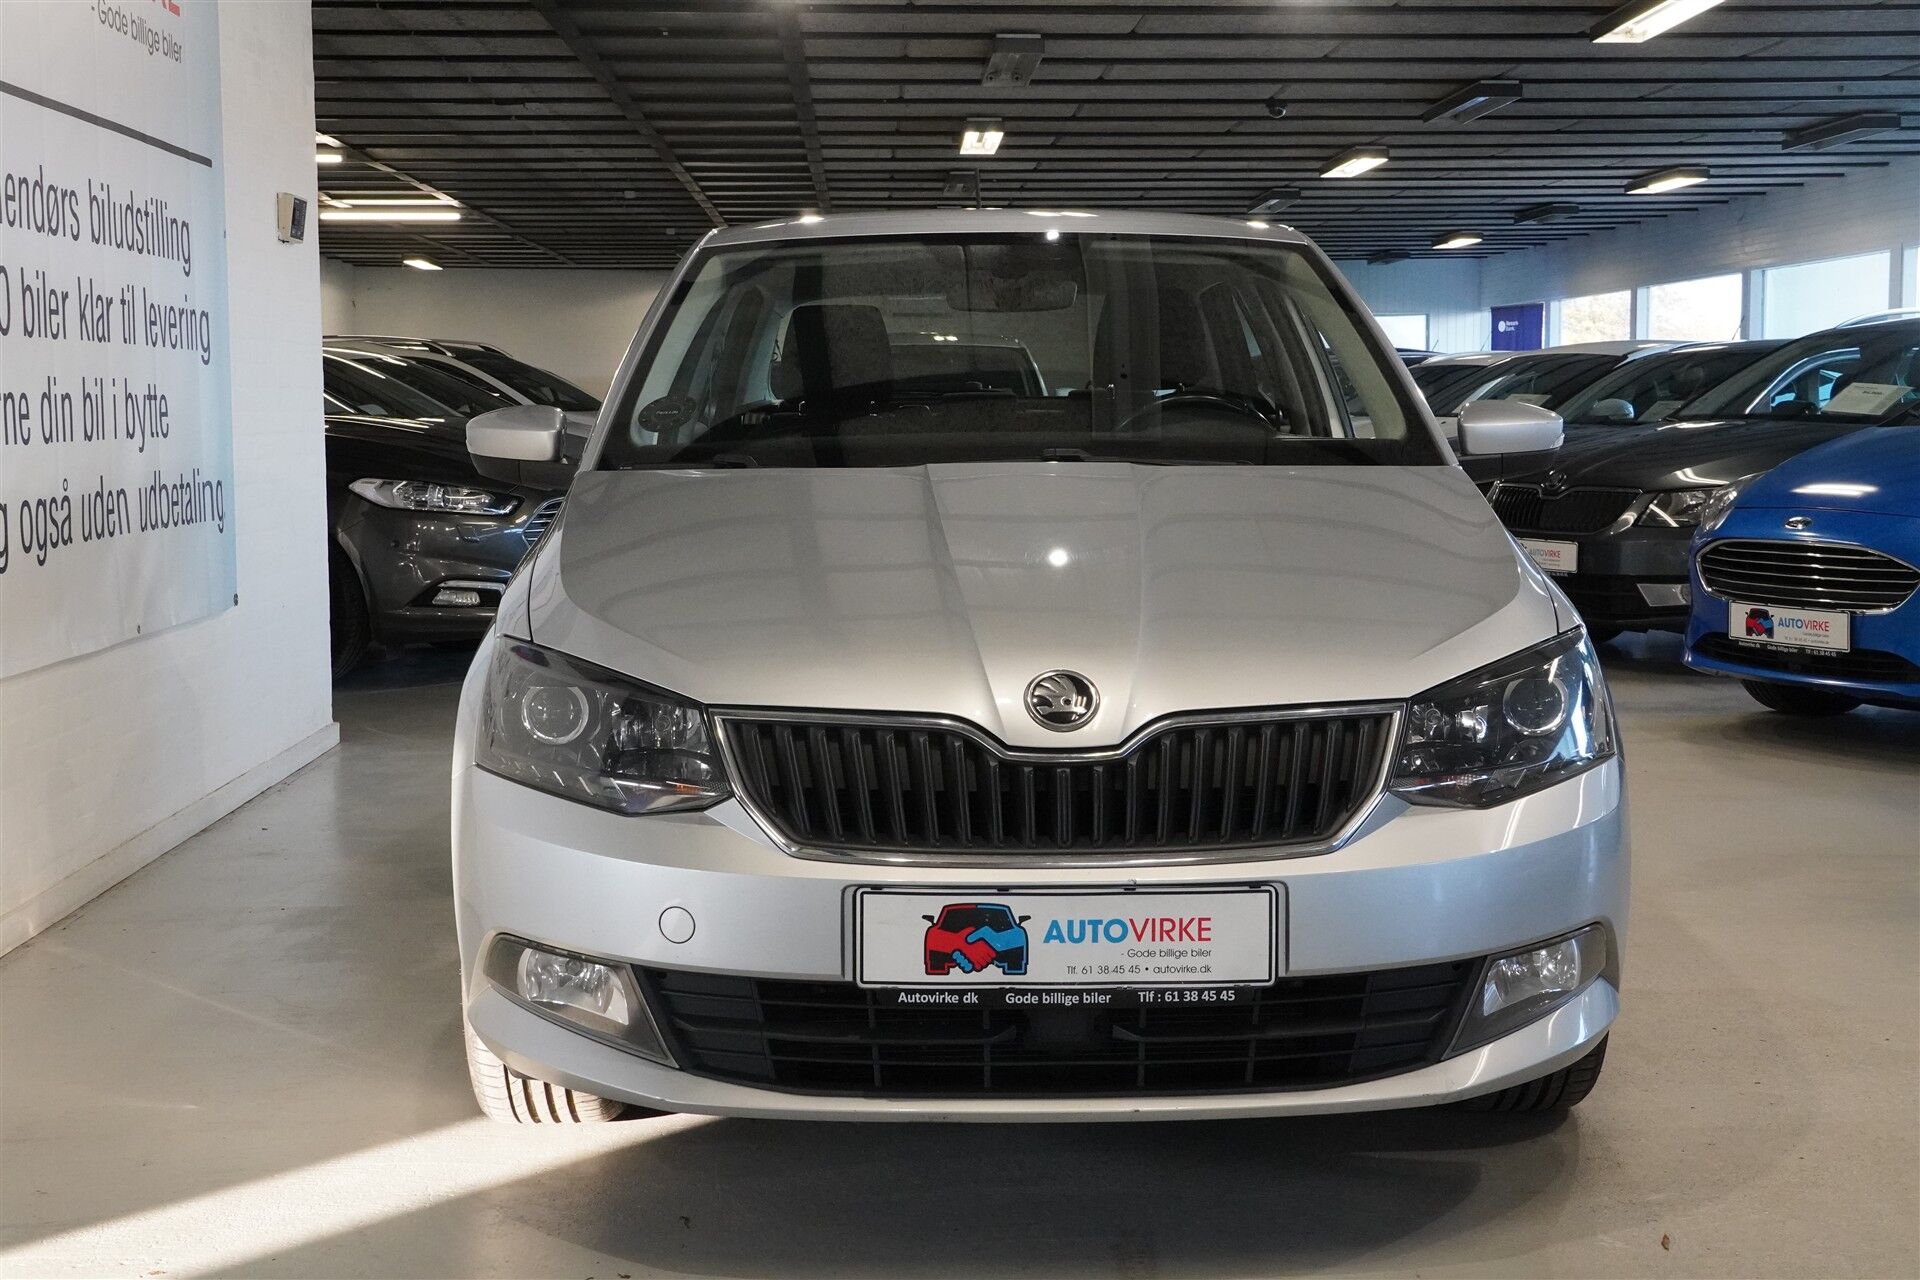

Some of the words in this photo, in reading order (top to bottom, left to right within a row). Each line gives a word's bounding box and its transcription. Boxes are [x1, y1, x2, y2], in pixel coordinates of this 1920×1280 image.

[98, 0, 128, 36] Gode
[130, 12, 160, 56] billige
[162, 29, 183, 64] biler
[0, 165, 80, 242] endørs
[88, 178, 192, 278] biludstilling
[20, 266, 69, 340] biler
[77, 276, 114, 344] klar
[120, 284, 137, 345] til
[143, 286, 211, 366] levering
[0, 391, 31, 446] ne
[40, 375, 74, 445] din
[82, 376, 105, 442] bil
[112, 377, 118, 439] i
[124, 377, 170, 453] bytte
[20, 478, 73, 567] også
[81, 475, 131, 542] uden
[138, 468, 226, 534] udbetaling
[1777, 616, 1830, 632] AUTOVIRKE
[1043, 917, 1212, 944] AUTOVIRKE
[1127, 948, 1157, 958] Gode
[1159, 948, 1188, 960] billige
[1190, 948, 1212, 958] biler
[1081, 965, 1093, 975] 61
[1097, 965, 1110, 975] 38
[1112, 965, 1125, 975] 45
[1128, 964, 1141, 974] 45
[1152, 964, 1212, 975] autovirke.dk
[898, 991, 959, 1004] Autovirke
[963, 991, 979, 1004] dk
[1005, 992, 1039, 1004] Gode
[1042, 991, 1080, 1006] billige
[1083, 991, 1112, 1004] biler
[1138, 990, 1155, 1003] Tlf
[1164, 990, 1179, 1002] 61
[1183, 990, 1199, 1001] 38
[1201, 990, 1217, 1001] 45
[1219, 989, 1235, 1001] 45
